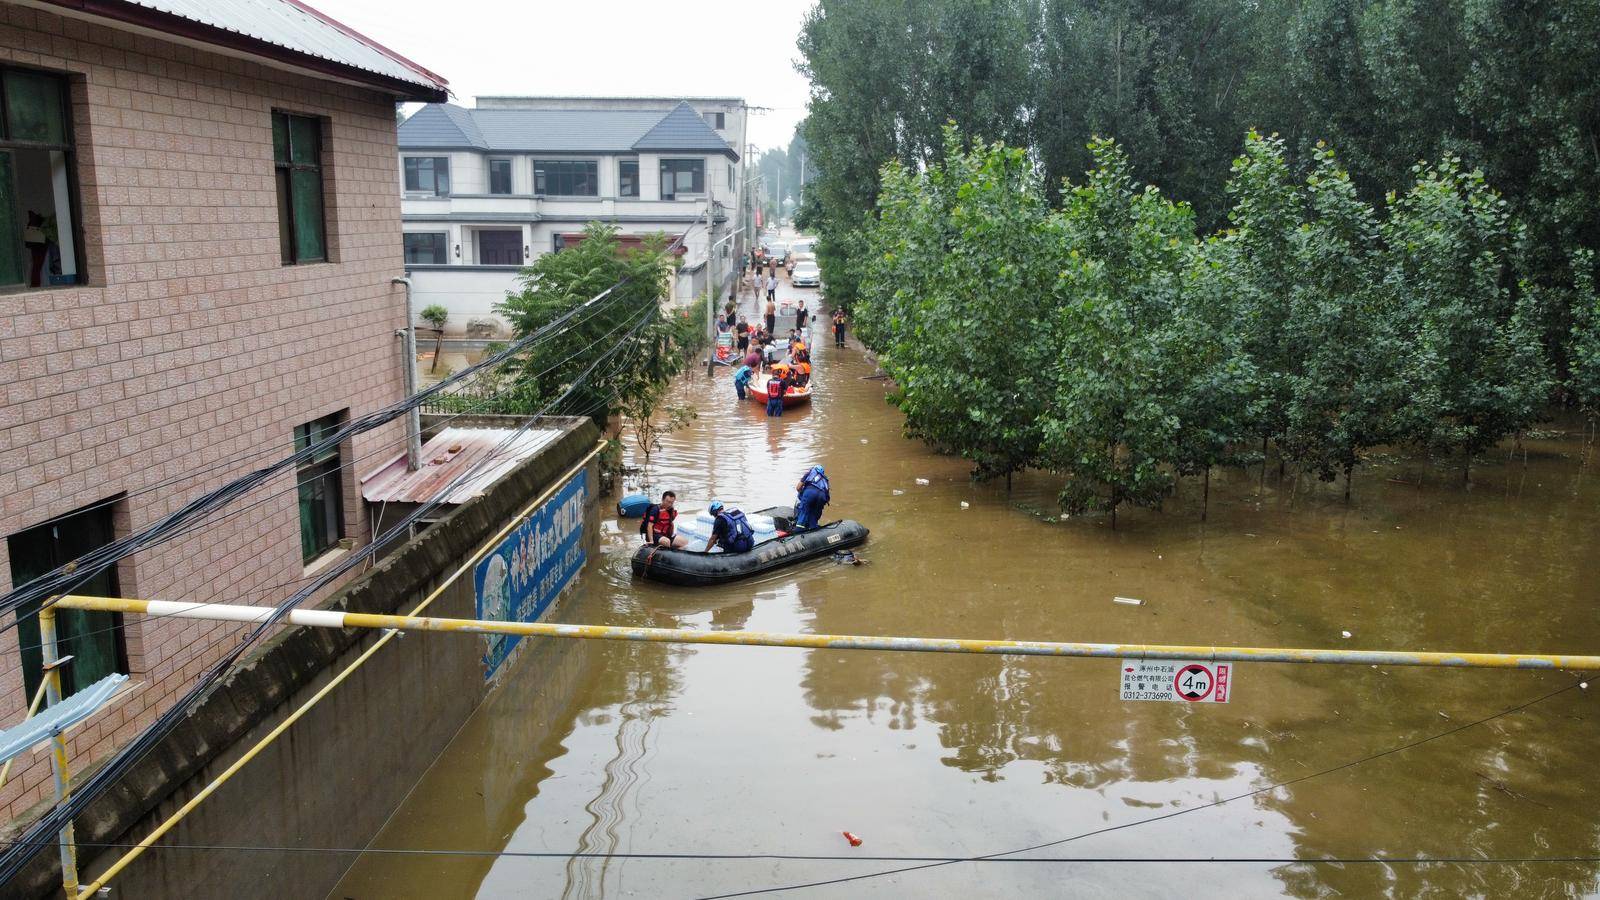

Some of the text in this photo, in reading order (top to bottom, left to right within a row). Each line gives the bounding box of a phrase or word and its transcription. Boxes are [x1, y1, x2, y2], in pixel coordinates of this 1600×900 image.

[1124, 674, 1175, 682] 昆仑燃气有限公司
[1183, 676, 1206, 690] 4m
[1123, 691, 1173, 700] 0312-3736990
